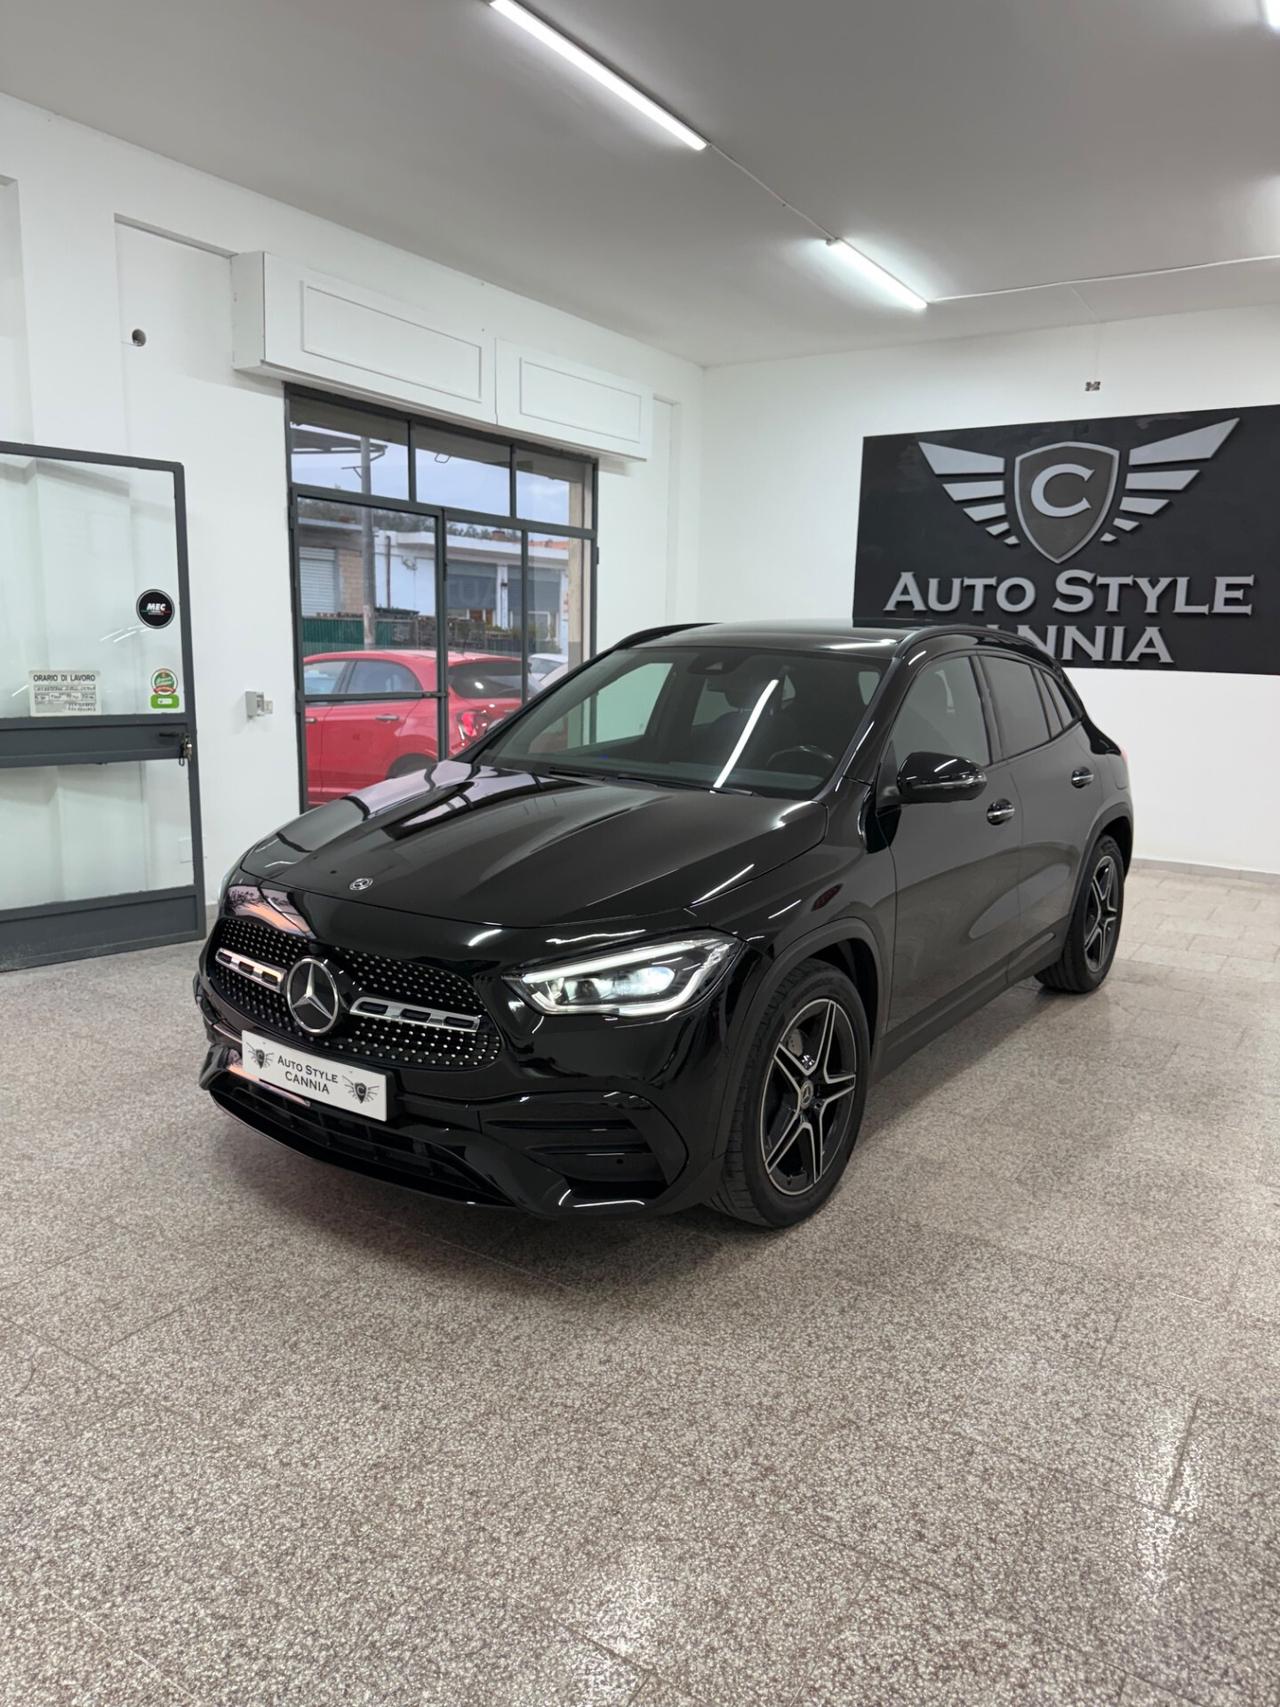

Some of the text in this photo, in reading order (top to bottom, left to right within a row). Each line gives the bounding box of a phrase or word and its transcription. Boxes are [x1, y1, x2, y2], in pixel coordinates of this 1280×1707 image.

[1030, 463, 1095, 518] C
[147, 603, 166, 611] MEC
[986, 624, 1174, 663] NNIA
[33, 674, 96, 682] ORARIO DI LAVORO
[285, 1071, 330, 1094] CANNIA
